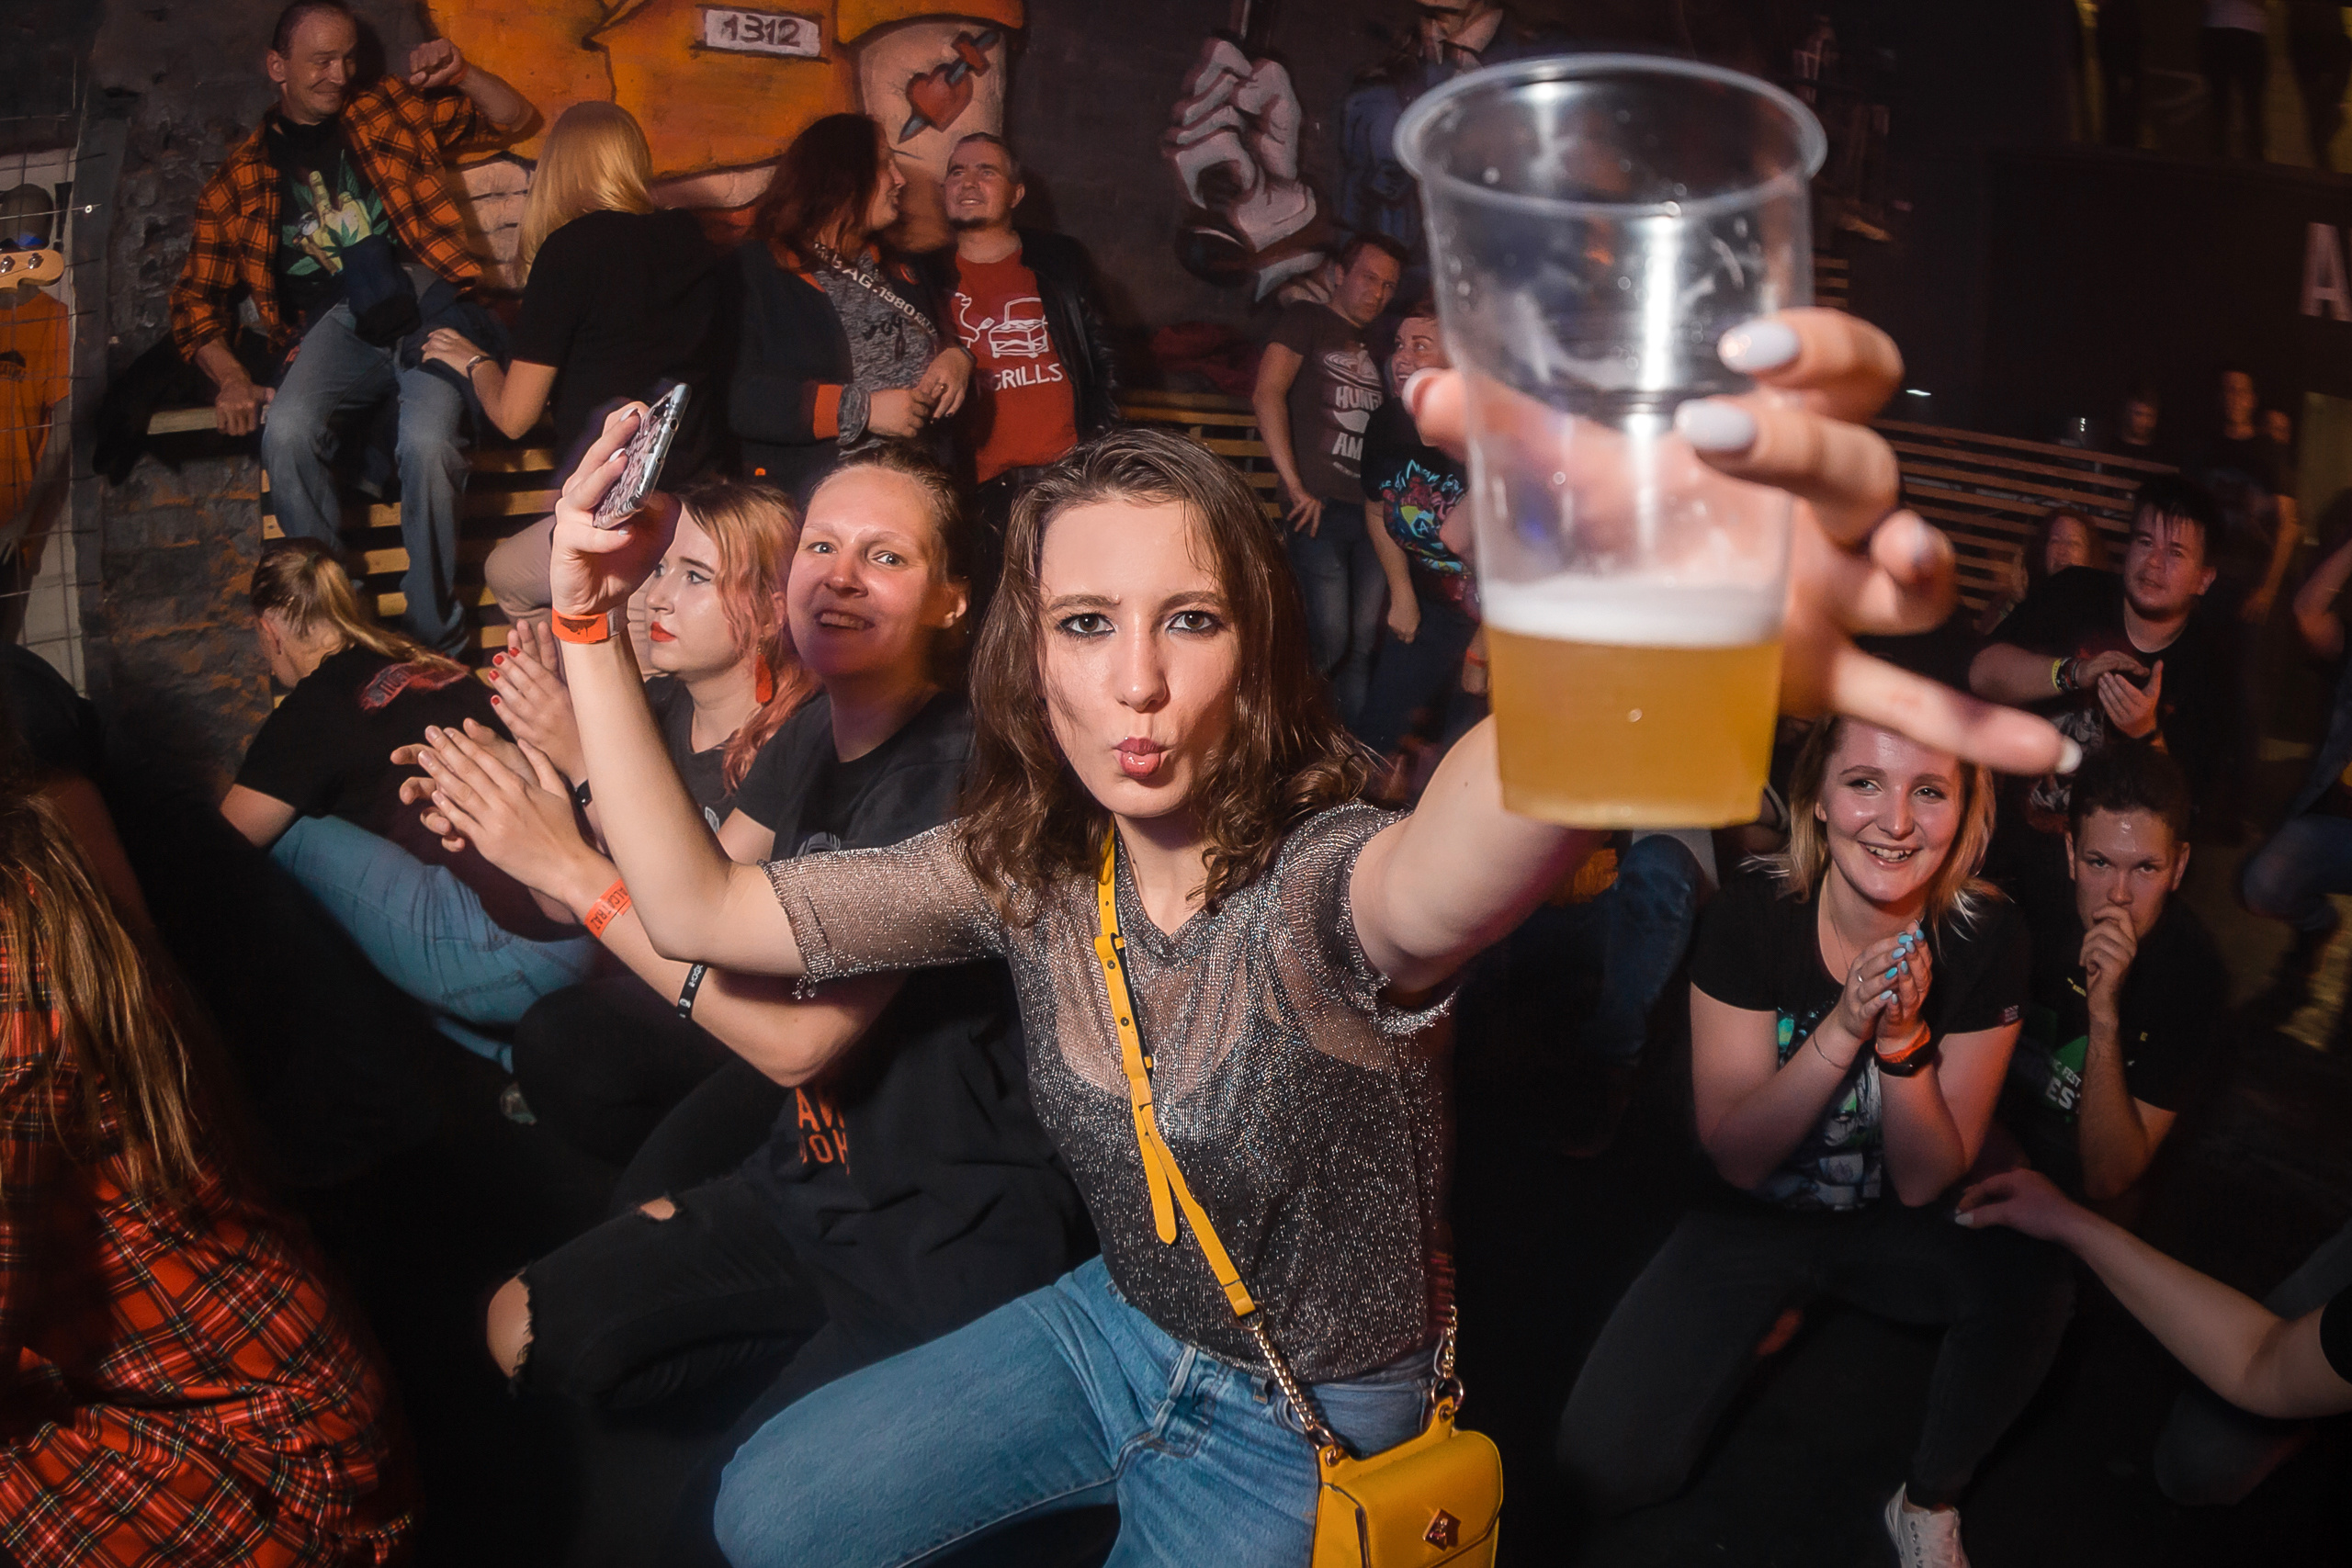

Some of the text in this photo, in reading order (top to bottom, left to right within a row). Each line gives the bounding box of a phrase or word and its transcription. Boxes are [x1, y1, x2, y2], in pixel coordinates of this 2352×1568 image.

[723, 14, 801, 47] 1312
[2299, 221, 2352, 322] A
[1336, 386, 1383, 412] HUNG
[590, 886, 628, 930] ALCATRAZ
[2062, 1066, 2082, 1088] FEST
